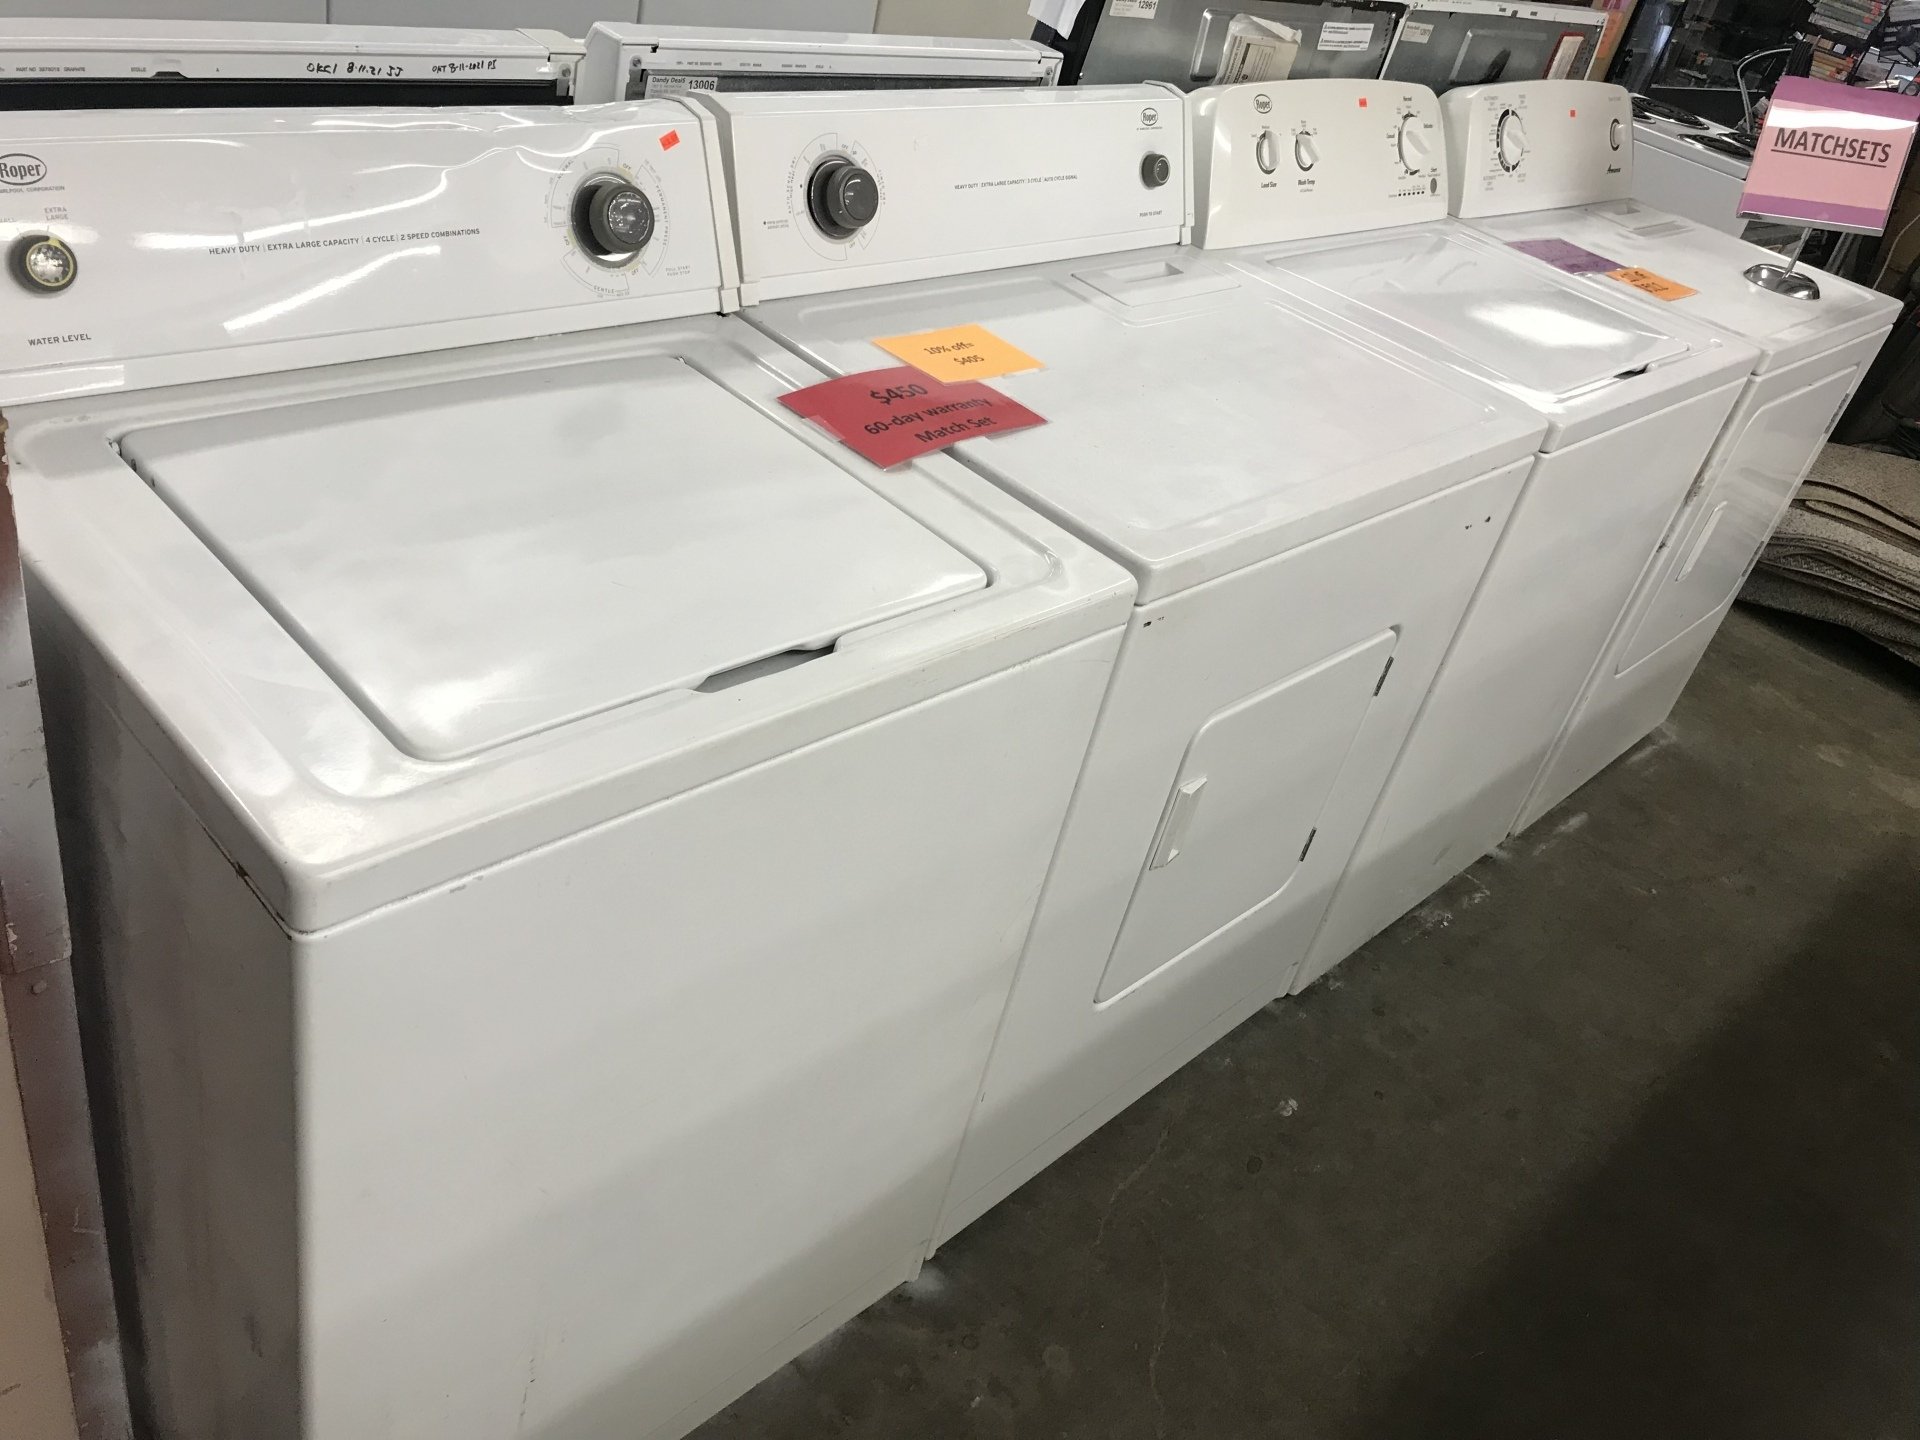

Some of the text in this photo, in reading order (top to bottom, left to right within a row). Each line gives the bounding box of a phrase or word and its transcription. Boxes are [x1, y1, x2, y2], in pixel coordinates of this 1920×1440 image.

[688, 80, 715, 91] 13006
[1142, 113, 1157, 123] Roper
[1774, 128, 1892, 163] MATCHSETS
[0, 162, 41, 180] Roper
[46, 213, 69, 221] LARGE
[208, 247, 237, 255] HEAVY
[239, 245, 260, 254] DUTY
[267, 243, 294, 251] EXTRA
[295, 240, 321, 249] LARGE
[323, 237, 360, 247] CAPACITY
[372, 234, 395, 243] CYCLE
[407, 231, 430, 240] SPEED
[430, 228, 481, 239] COMBINATIONS
[28, 333, 92, 346] WATER LEVEL
[924, 345, 951, 355] 10%
[953, 354, 985, 366] $405
[870, 383, 928, 406] $450
[864, 397, 992, 436] 60-day warranty
[914, 415, 997, 443] Match Set
